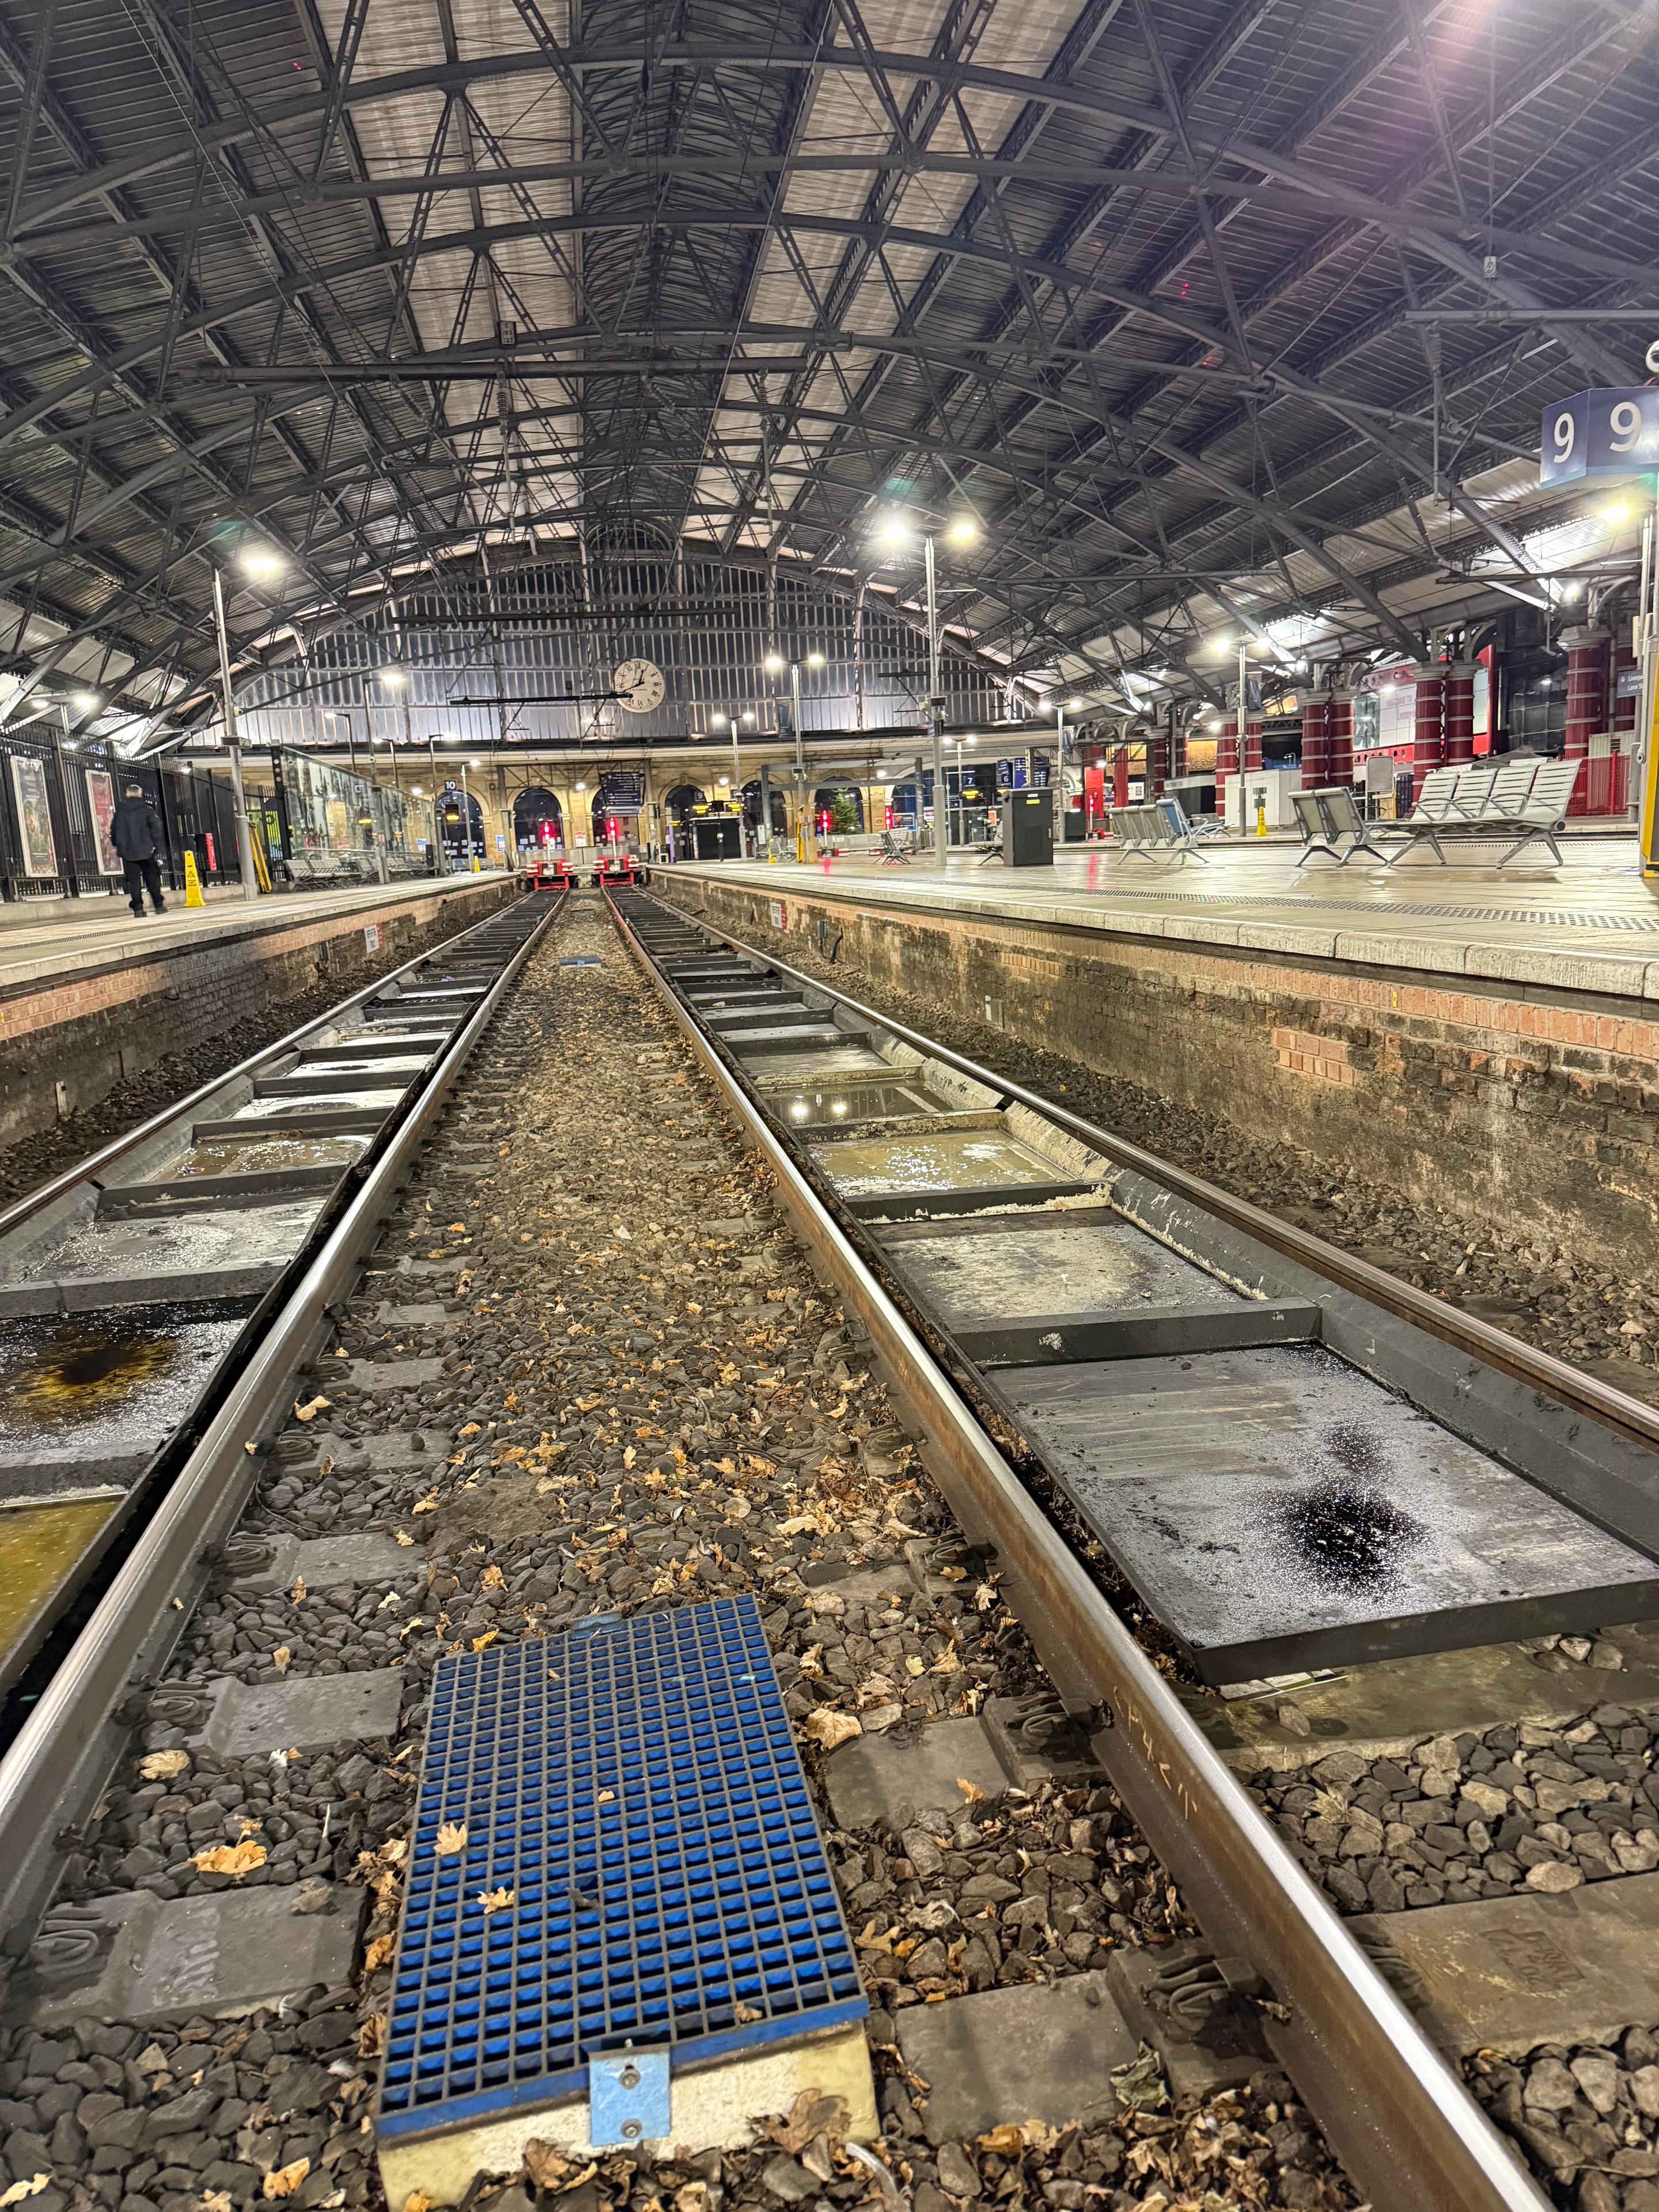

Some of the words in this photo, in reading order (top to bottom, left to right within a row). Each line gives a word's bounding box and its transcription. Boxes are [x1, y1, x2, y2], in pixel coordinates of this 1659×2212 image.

[1554, 412, 1575, 463] 9
[1609, 402, 1642, 452] 9
[445, 781, 456, 789] 10
